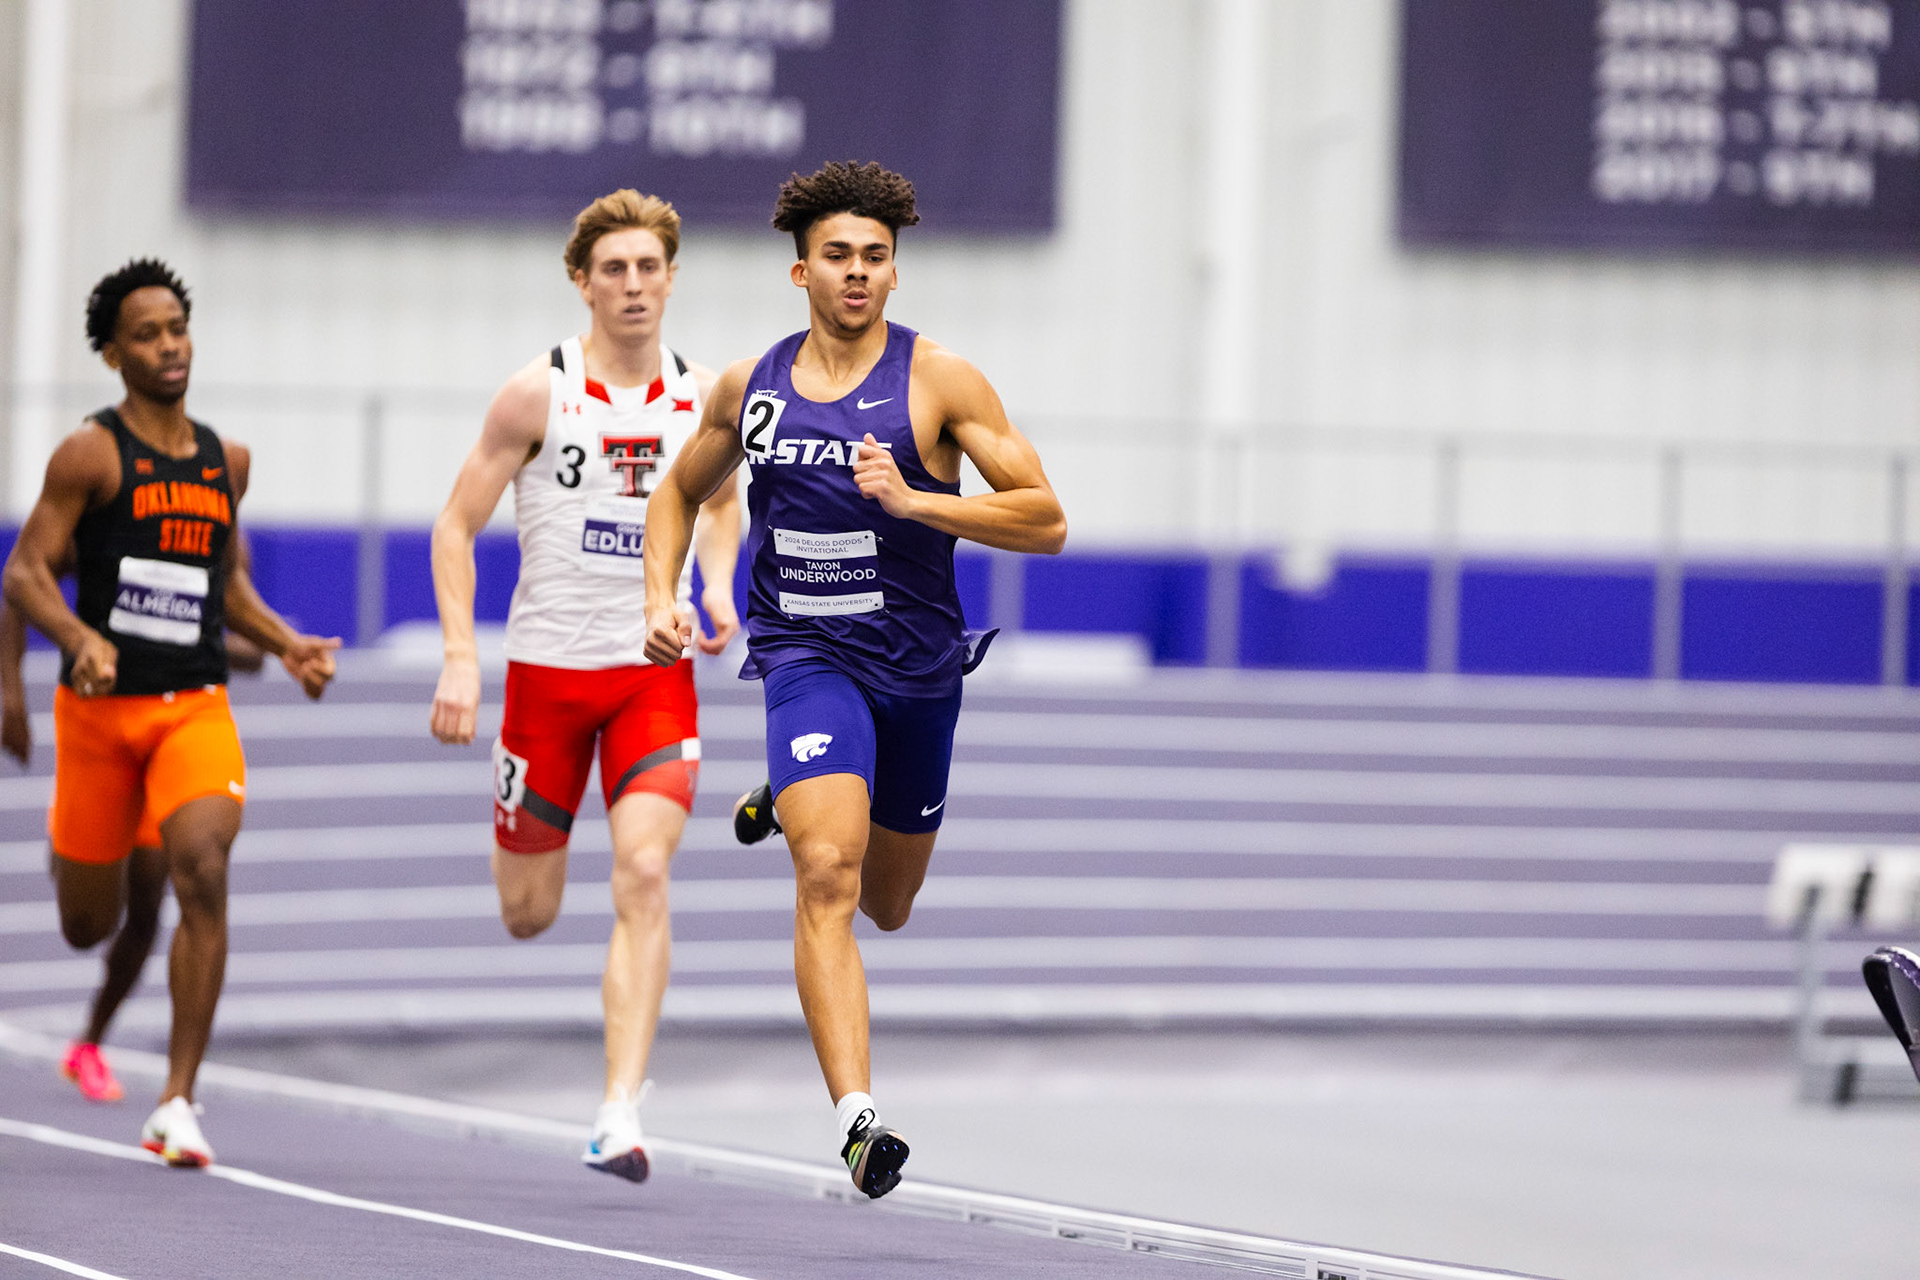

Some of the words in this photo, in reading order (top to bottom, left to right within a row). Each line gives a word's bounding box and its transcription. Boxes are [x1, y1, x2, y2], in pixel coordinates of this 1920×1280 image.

[746, 401, 774, 453] 2
[557, 445, 586, 488] 3
[133, 481, 231, 525] OKLAHOMA
[160, 519, 213, 556] STATE
[584, 529, 645, 556] EDLU
[796, 546, 849, 554] INVITATIONAL
[832, 539, 863, 547] DODDS
[780, 567, 876, 583] UNDERWOOD
[805, 561, 840, 570] TAVON
[117, 589, 202, 620] ALMEIDA
[833, 598, 873, 607] UNIVERSITY
[500, 757, 516, 800] 3
